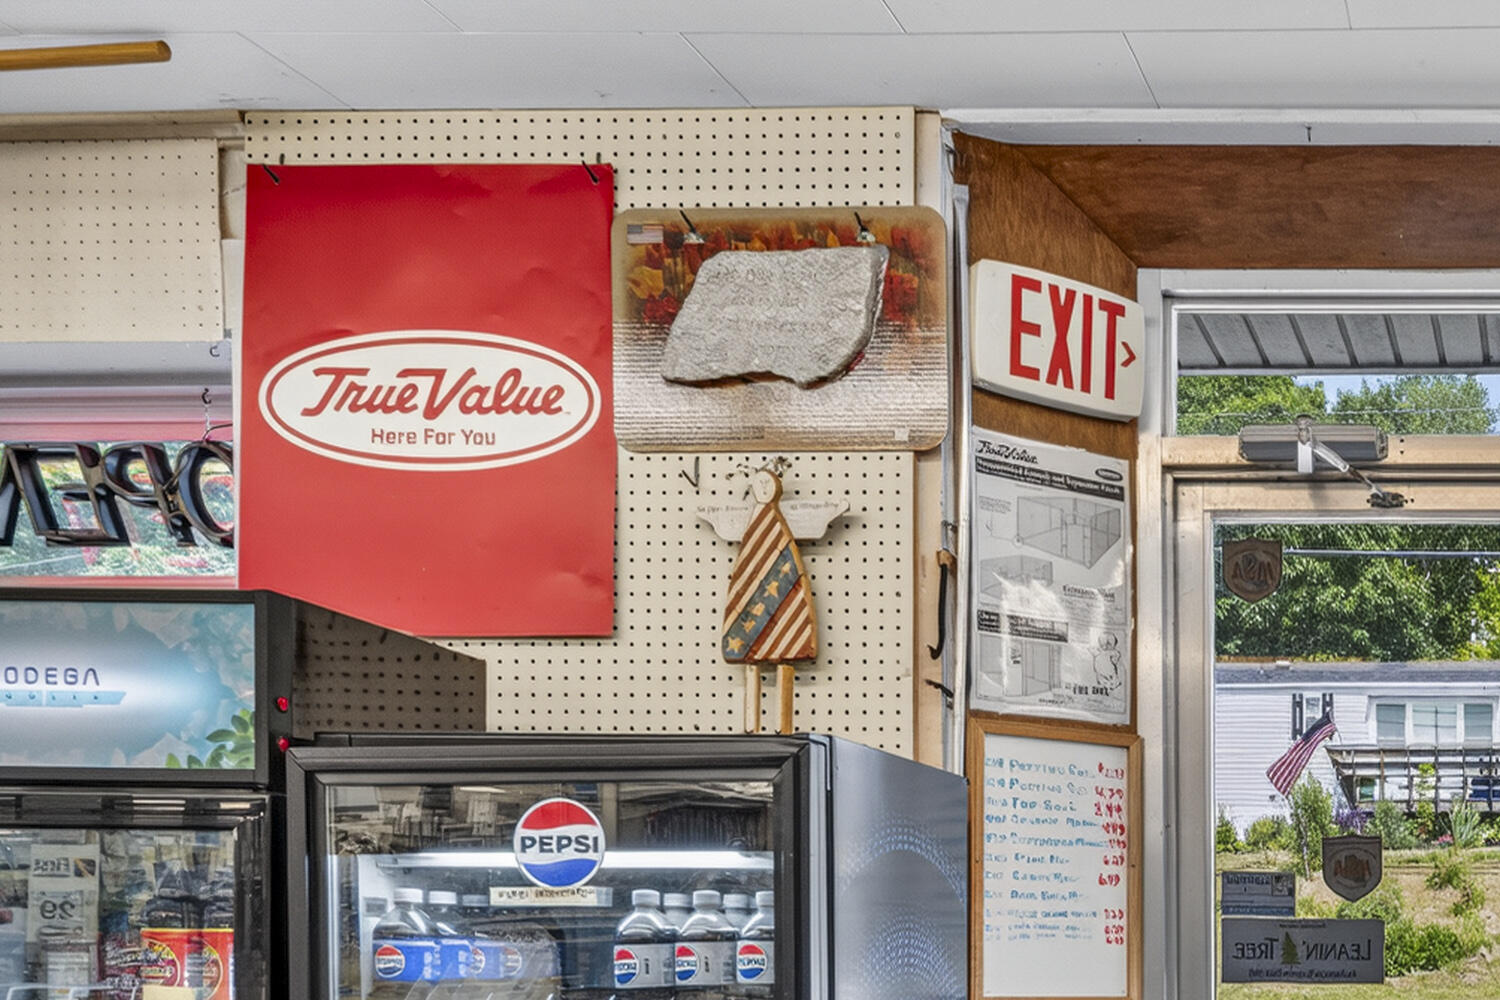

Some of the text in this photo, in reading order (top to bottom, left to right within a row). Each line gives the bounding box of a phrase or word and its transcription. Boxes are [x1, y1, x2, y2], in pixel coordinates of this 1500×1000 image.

[1010, 273, 1125, 401] EXIT
[371, 428, 497, 446] Here For You
[520, 835, 599, 853] PEPSI
